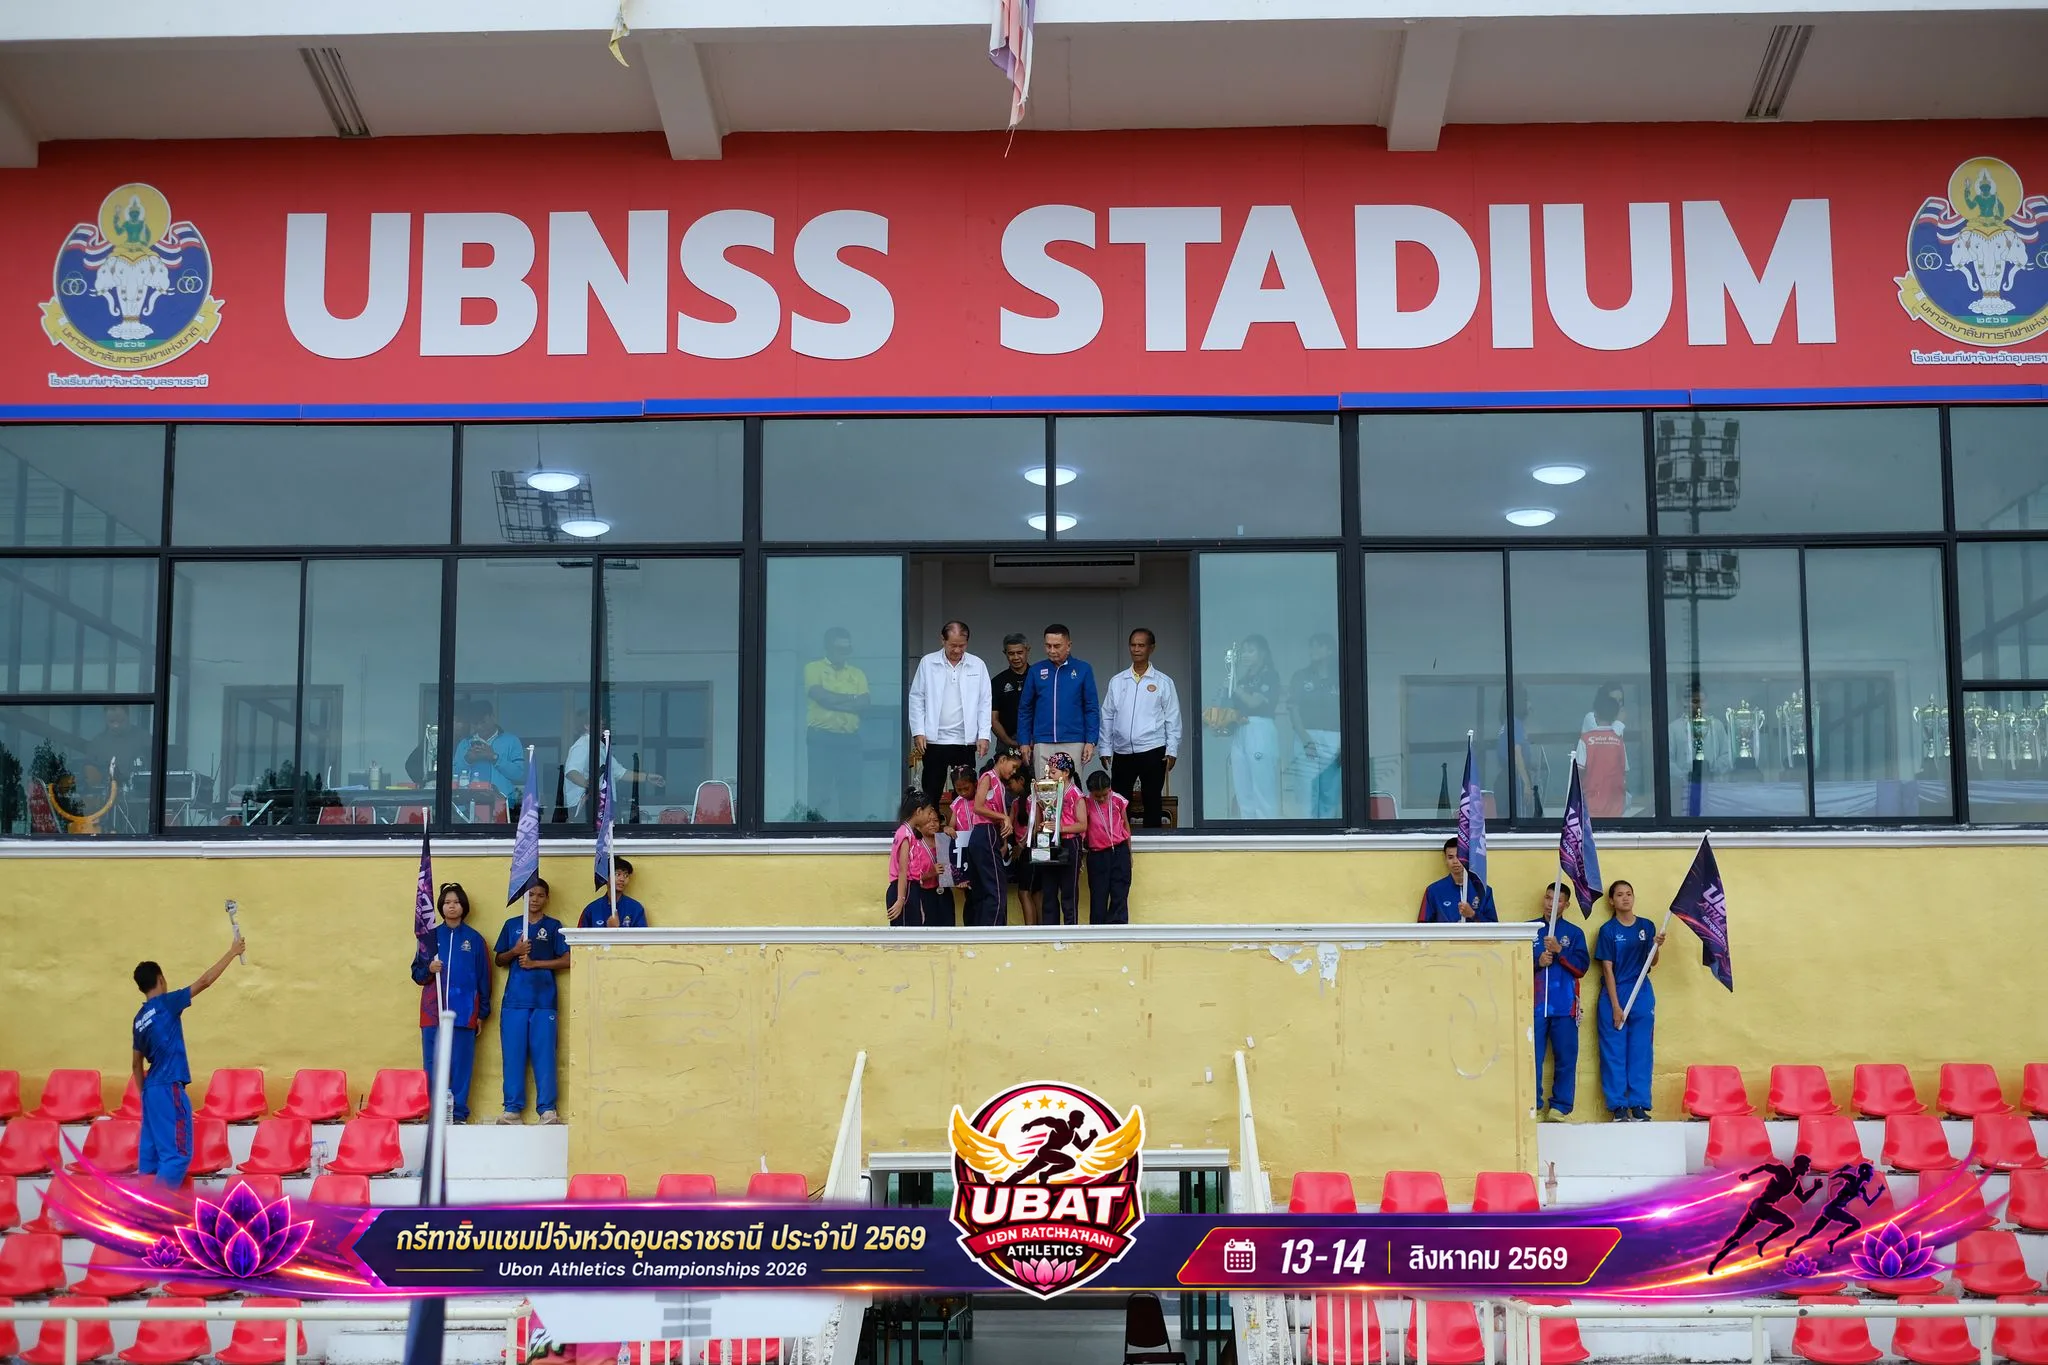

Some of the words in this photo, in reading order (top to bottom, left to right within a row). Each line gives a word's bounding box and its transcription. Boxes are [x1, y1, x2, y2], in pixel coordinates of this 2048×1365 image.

[284, 208, 895, 361] UBNSS
[998, 197, 1838, 356] STADIUM
[1920, 302, 2048, 340] มหาวิทยาลัยการกีฬาแห่ง
[1912, 351, 2048, 365] โรงเรียนกีฬาจังหวัดอุบลรา
